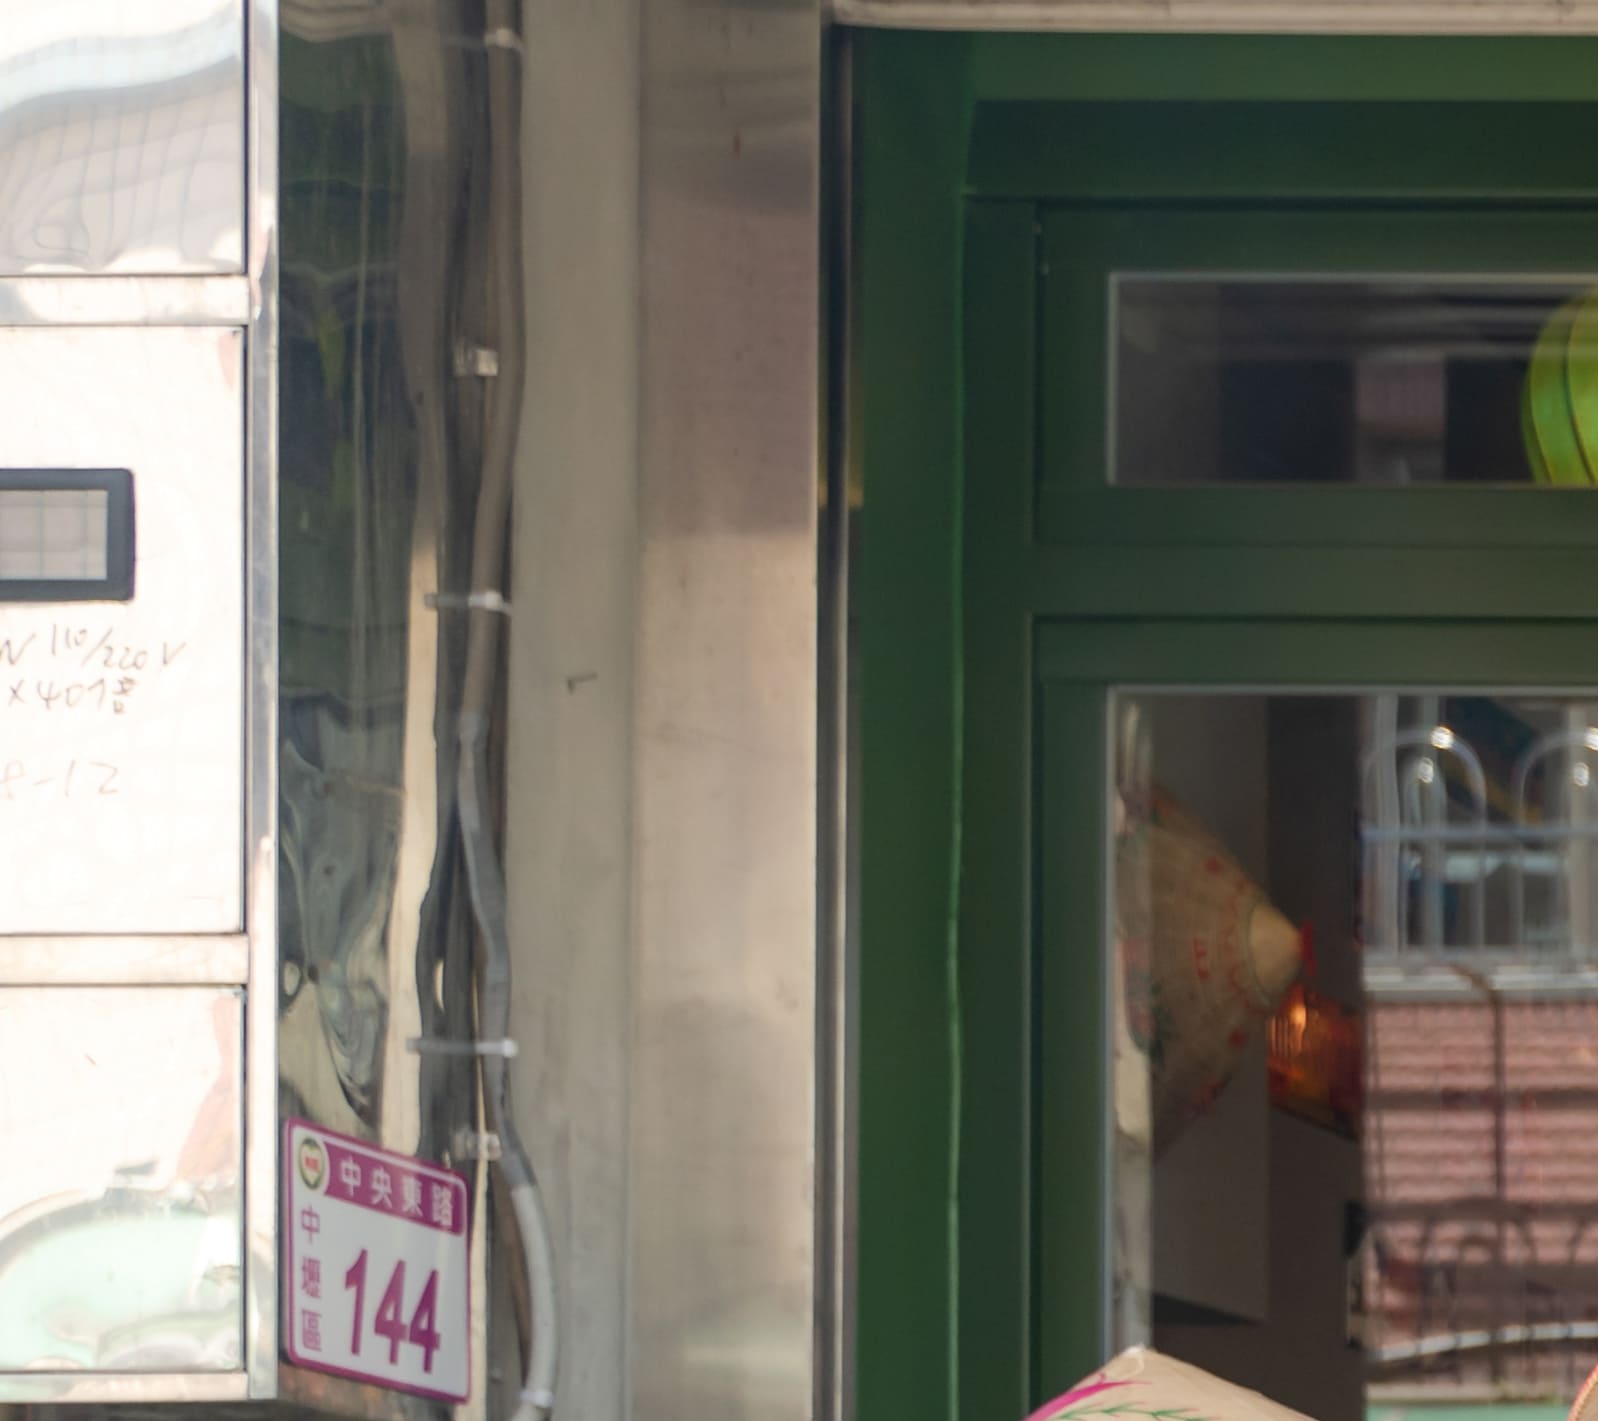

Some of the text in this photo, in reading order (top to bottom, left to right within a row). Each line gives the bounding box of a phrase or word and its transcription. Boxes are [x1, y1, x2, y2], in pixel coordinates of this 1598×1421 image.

[340, 1157, 454, 1227] 中央東路
[344, 1248, 441, 1375] 144
